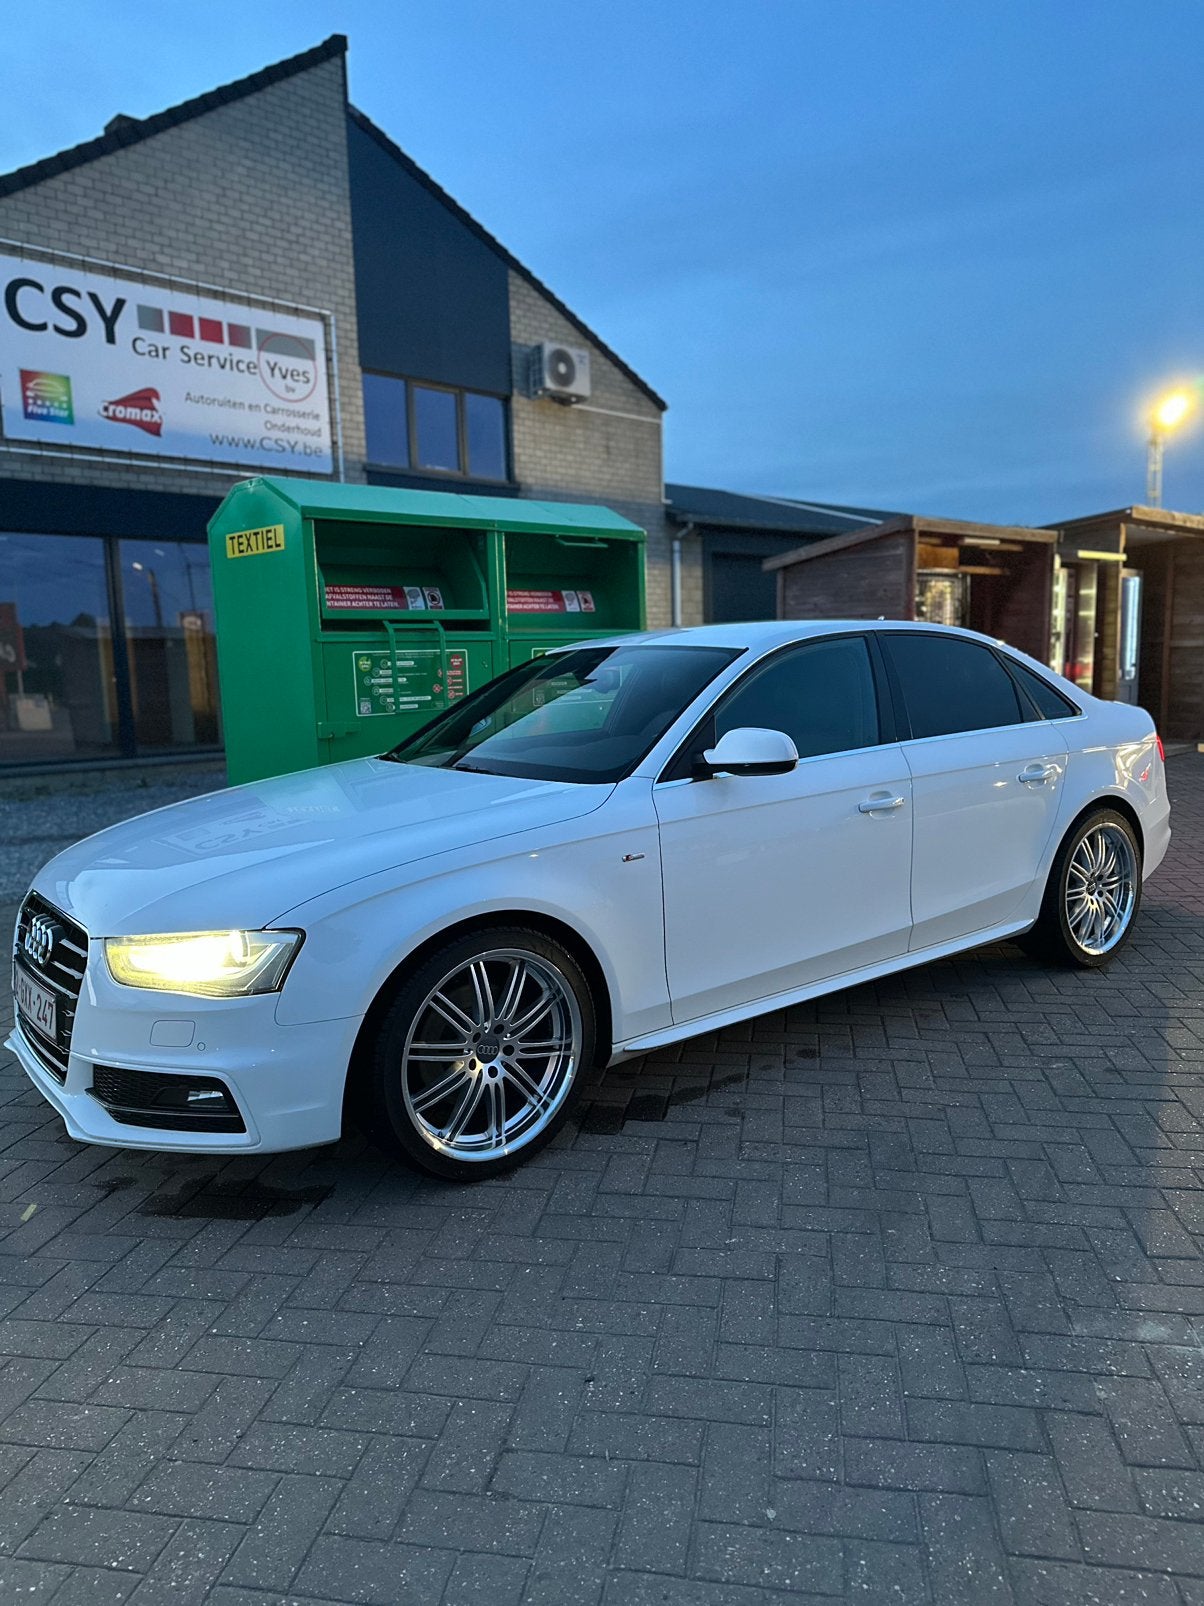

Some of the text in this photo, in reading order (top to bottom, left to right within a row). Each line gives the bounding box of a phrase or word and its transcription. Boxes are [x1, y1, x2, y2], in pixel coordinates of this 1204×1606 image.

[4, 277, 127, 345] CSY
[131, 336, 311, 384] Car Service Yves
[184, 391, 321, 421] Autoruiten en Carrosserie
[264, 419, 322, 437] Onderhoud
[208, 433, 323, 458] www.CSY.be
[228, 527, 282, 556] TEXTIEL
